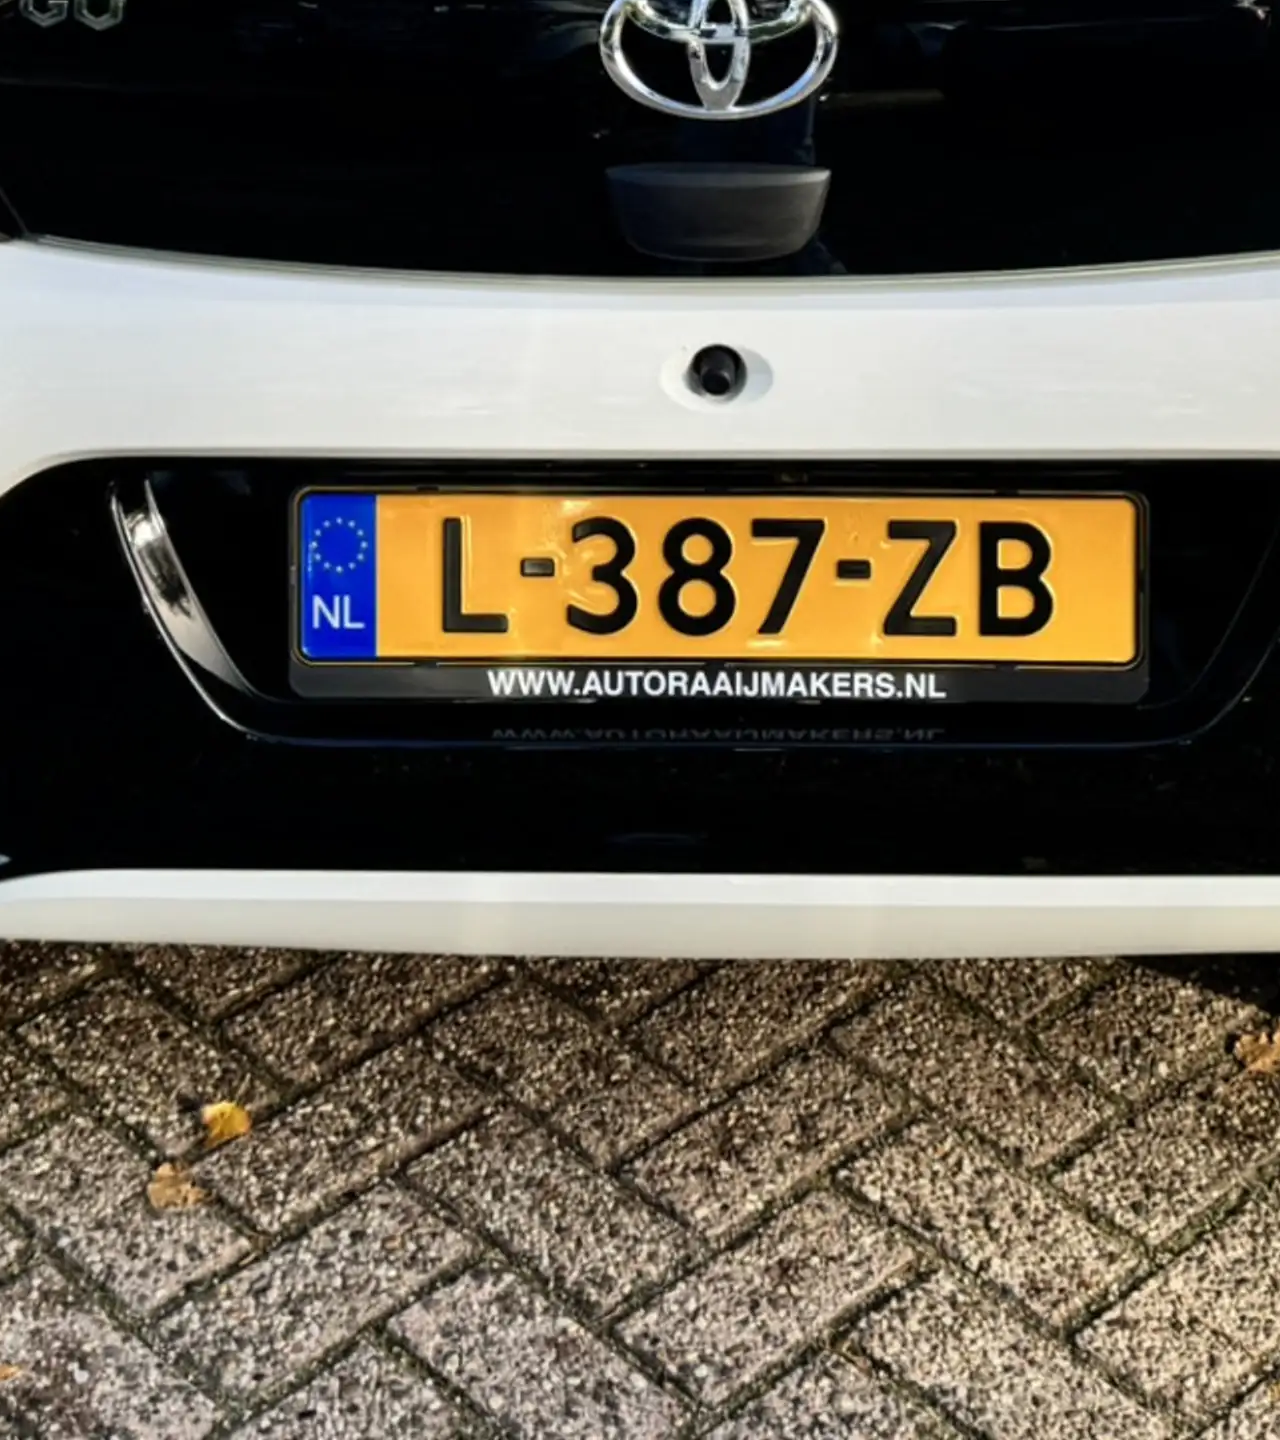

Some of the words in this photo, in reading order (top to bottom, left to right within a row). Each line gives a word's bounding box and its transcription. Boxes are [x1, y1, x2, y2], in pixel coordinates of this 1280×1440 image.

[441, 515, 1055, 638] L-387-ZB
[312, 593, 366, 630] NL
[487, 669, 947, 700] WWW.AUTORAAIJMAKERS.NL
